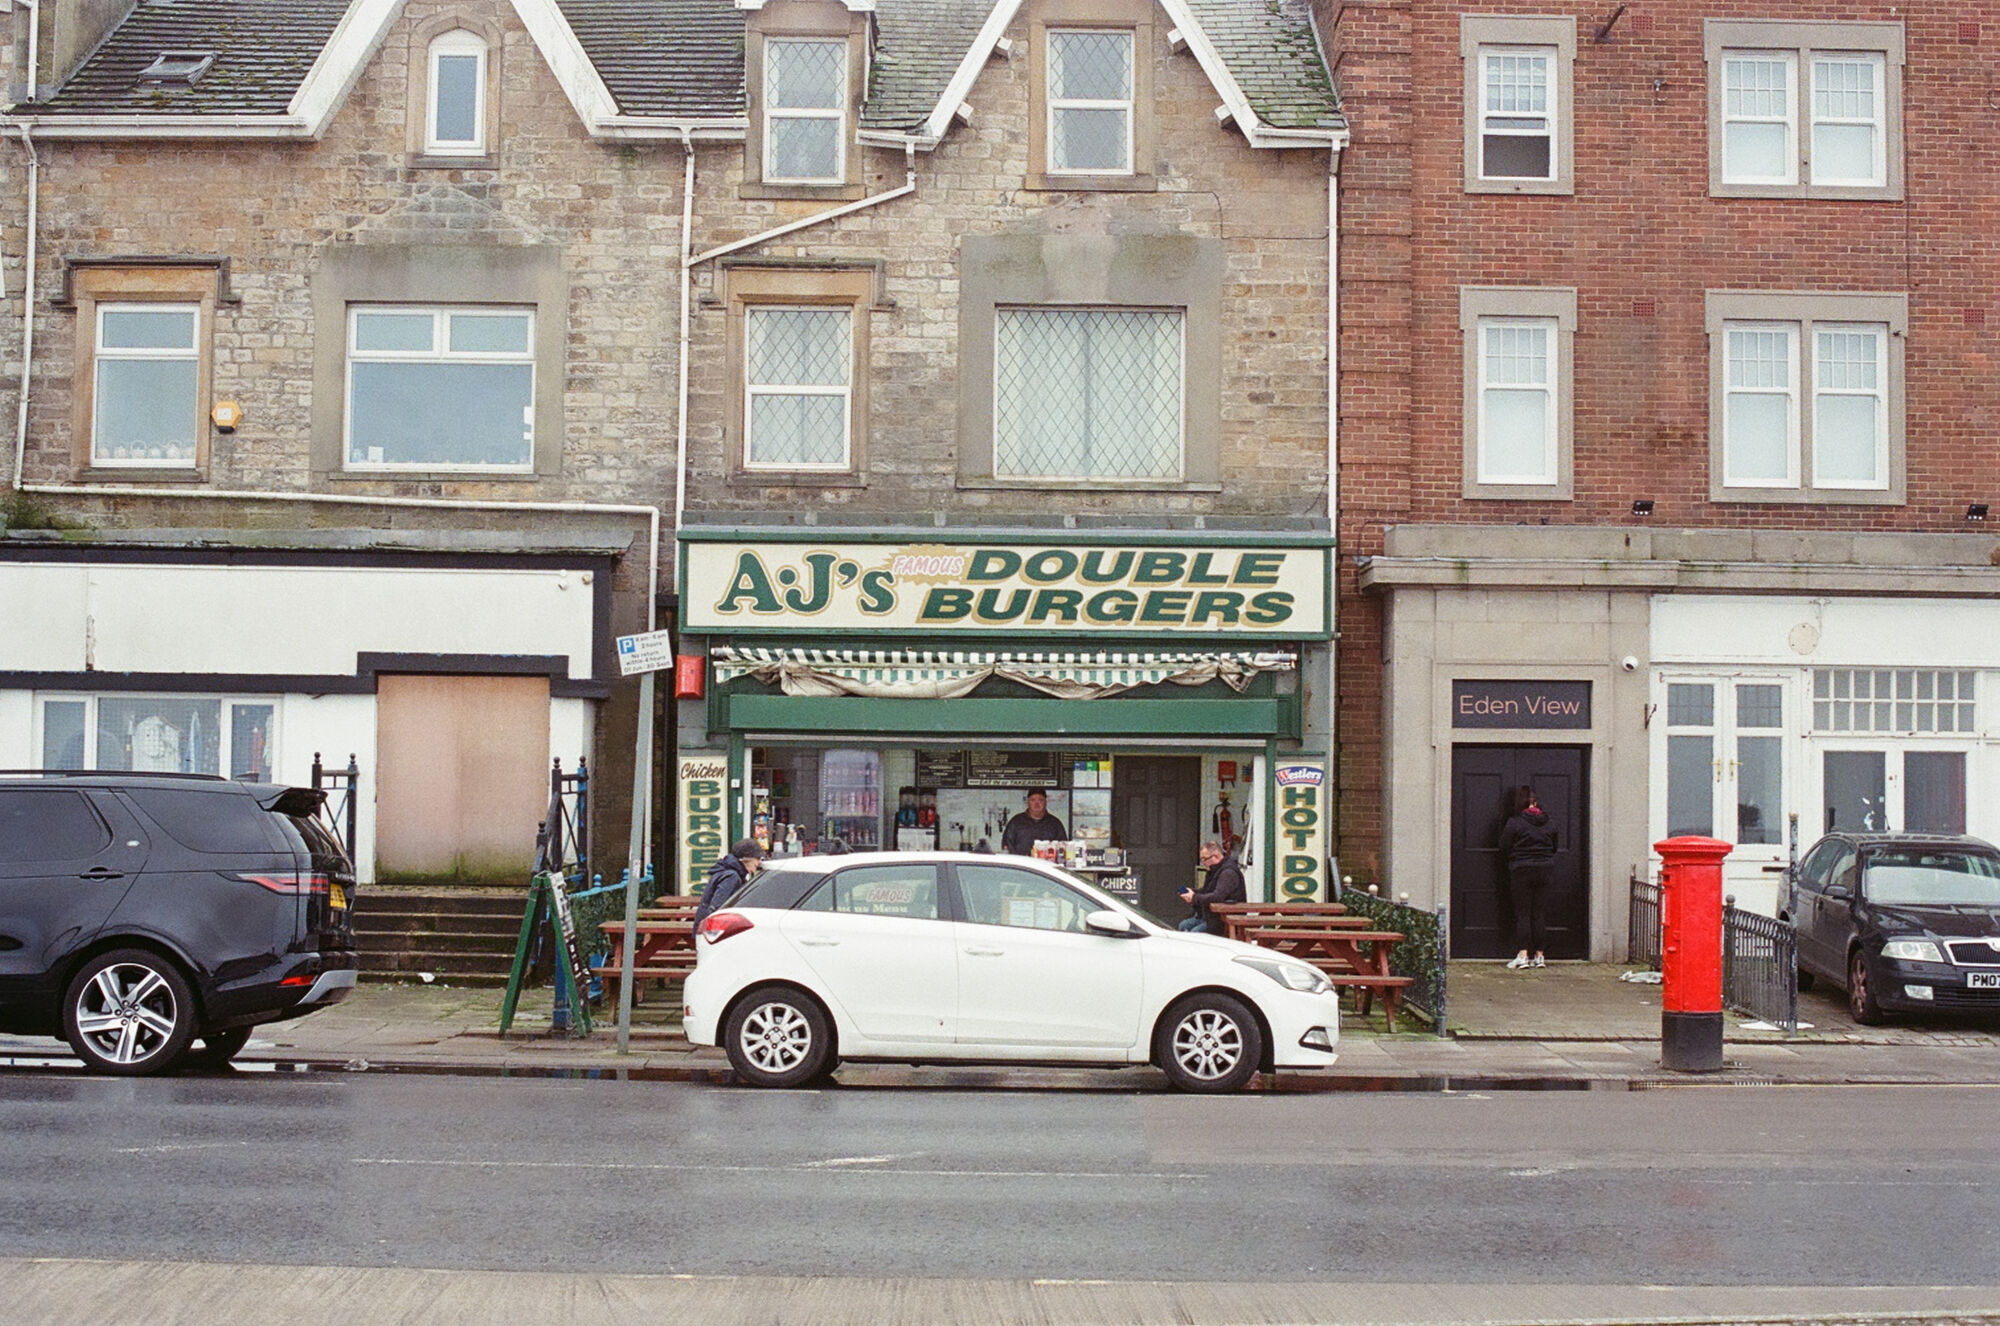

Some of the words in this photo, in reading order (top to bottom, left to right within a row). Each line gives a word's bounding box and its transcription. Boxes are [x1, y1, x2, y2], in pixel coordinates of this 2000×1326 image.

[893, 555, 963, 576] FAMOUS
[962, 550, 1287, 588] DOUBLE
[917, 588, 1295, 627] BURGERS
[1459, 694, 1518, 714] Eden
[1524, 695, 1581, 715] View
[680, 761, 727, 780] Chicken
[1275, 767, 1322, 783] Westlers
[1281, 787, 1318, 851] HOT
[1101, 877, 1137, 890] CHIPS!
[867, 888, 911, 902] FAMOUS
